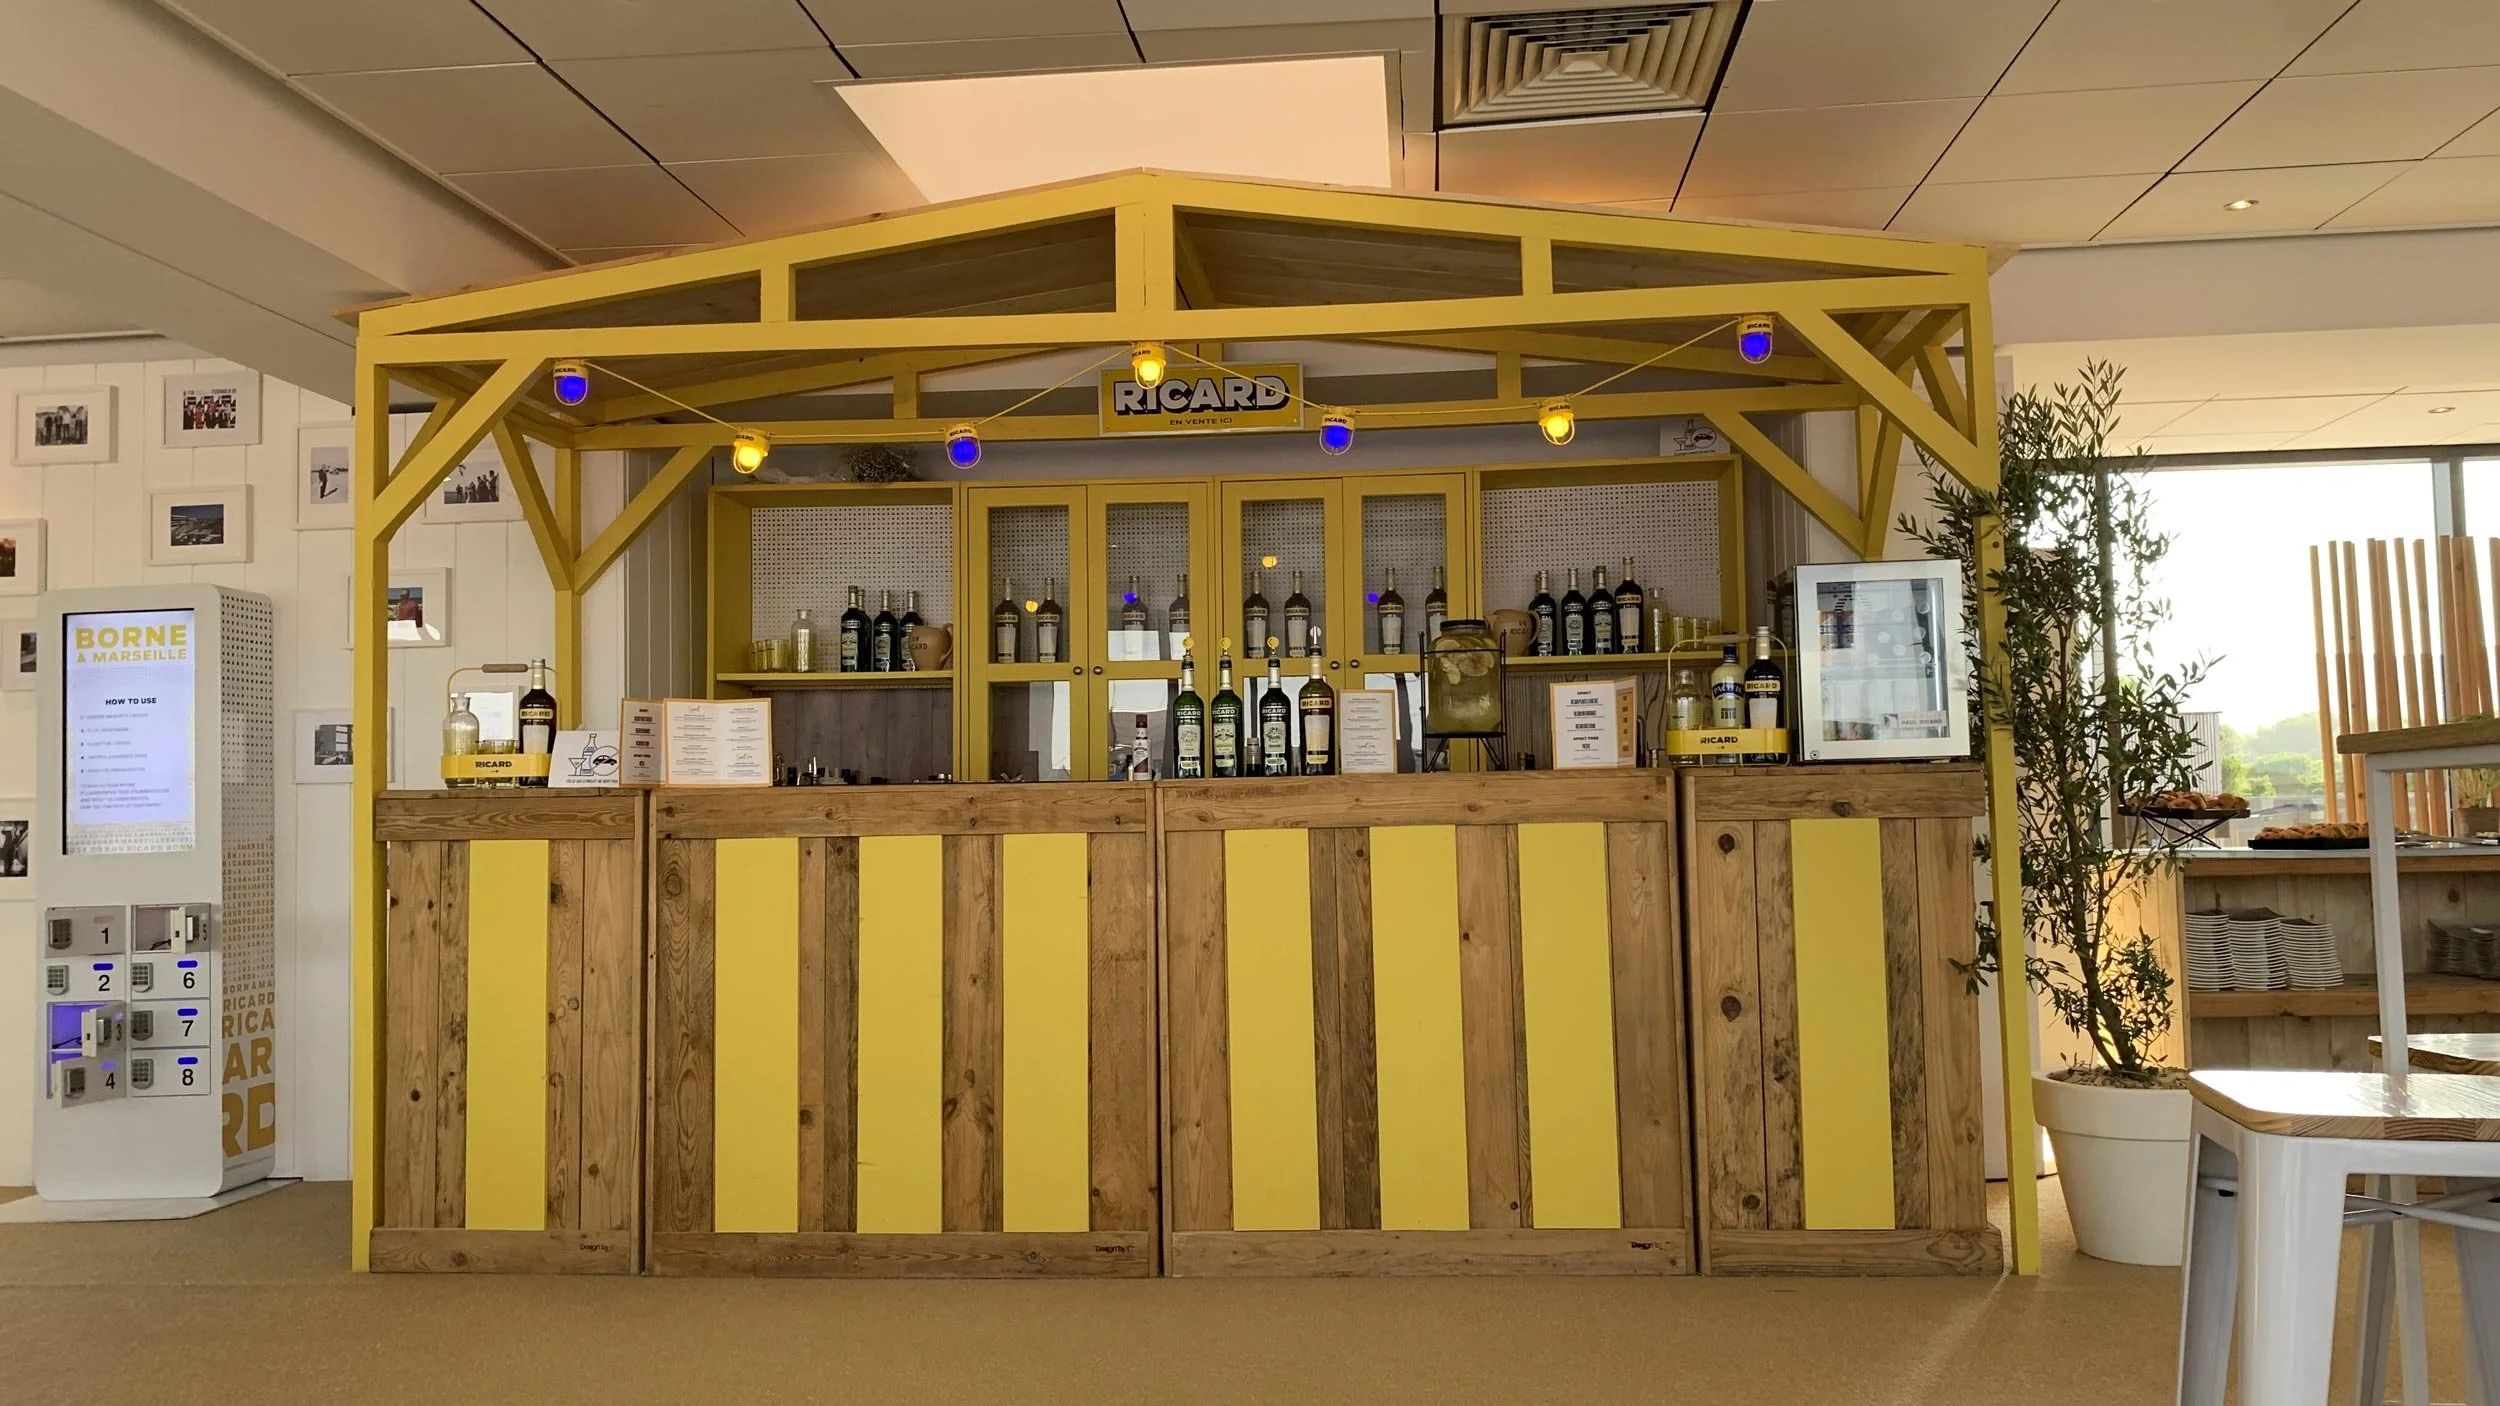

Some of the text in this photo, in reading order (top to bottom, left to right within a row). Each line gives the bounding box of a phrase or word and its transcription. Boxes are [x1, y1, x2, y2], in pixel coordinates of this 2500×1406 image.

[1113, 375, 1291, 415] RICARD
[75, 623, 188, 650] BORNE
[92, 648, 188, 663] MARSEILLE
[105, 698, 126, 706] HOW
[1700, 736, 1739, 745] RICARD
[475, 761, 513, 769] RICARD
[101, 927, 109, 944] 1
[202, 924, 208, 941] 5
[98, 974, 111, 992] 2
[183, 971, 195, 989] 6
[222, 991, 275, 1012] RICARD
[116, 1023, 122, 1041] 3
[182, 1020, 194, 1037] 7
[221, 1007, 275, 1040] RICA
[222, 1036, 273, 1085] AR
[105, 1072, 116, 1090] 4
[182, 1068, 194, 1086] 8
[222, 1082, 276, 1158] RD
